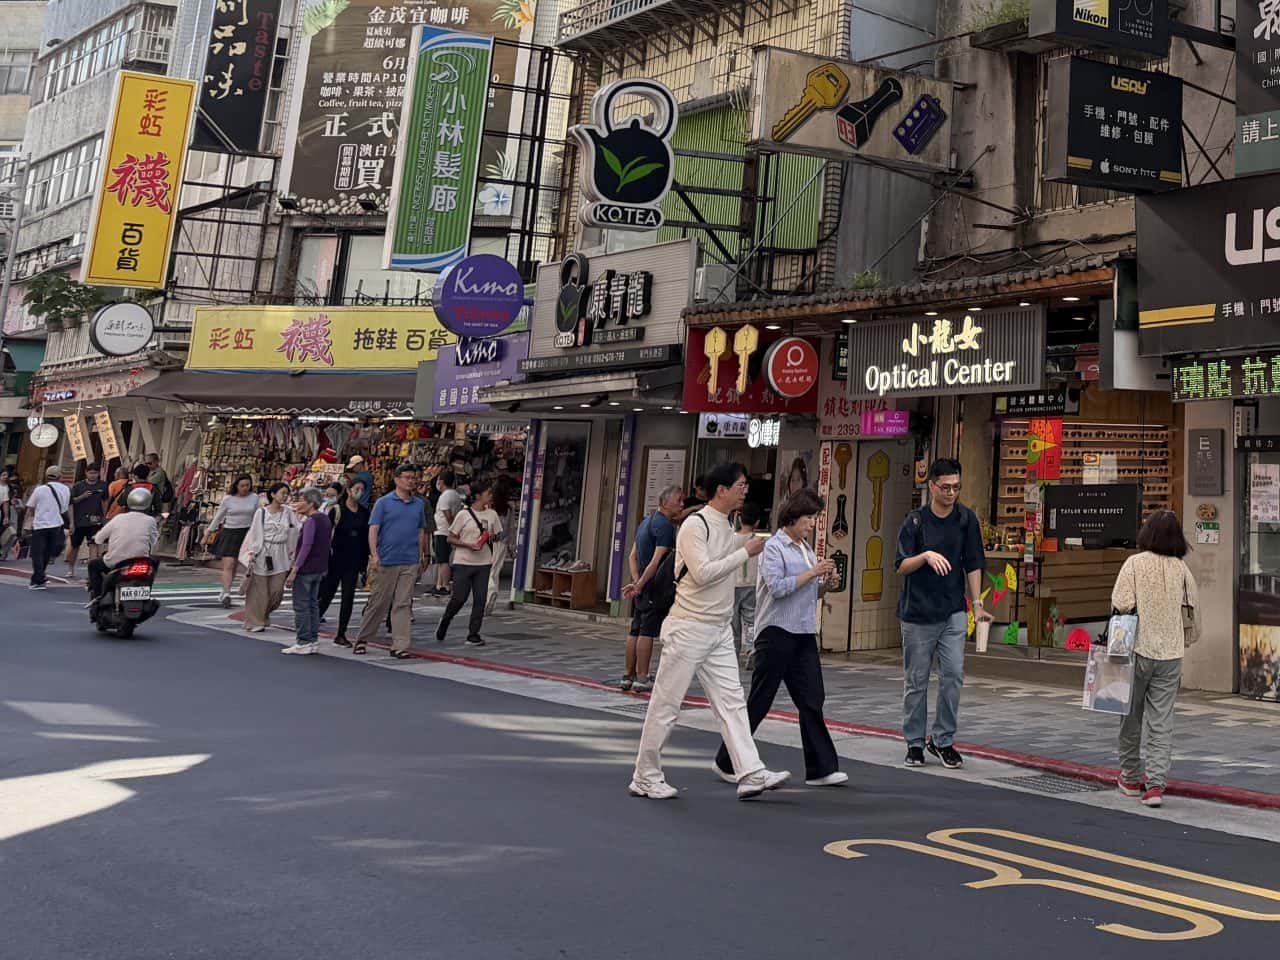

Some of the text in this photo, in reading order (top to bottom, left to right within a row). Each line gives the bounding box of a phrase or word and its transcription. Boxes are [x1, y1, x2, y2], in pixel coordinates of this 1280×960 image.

[368, 6, 469, 25] 金茂宜咖啡
[1074, 7, 1108, 27] Nikon
[248, 11, 274, 91] Taste
[138, 88, 168, 137] 彩虹
[348, 99, 368, 107] fruit
[1083, 103, 1170, 133] 手機 門號 配件
[1099, 123, 1155, 146] 維修 包膜
[427, 86, 467, 213] 小林髮廊
[1112, 163, 1138, 176] SONY
[116, 222, 145, 272] 百貨
[1221, 301, 1246, 318] 手機
[208, 327, 256, 351] 彩虹
[352, 327, 397, 352] 拖鞋
[404, 328, 449, 352] 百貨
[902, 315, 985, 359] 小龍女
[865, 358, 1017, 397] Optical Center
